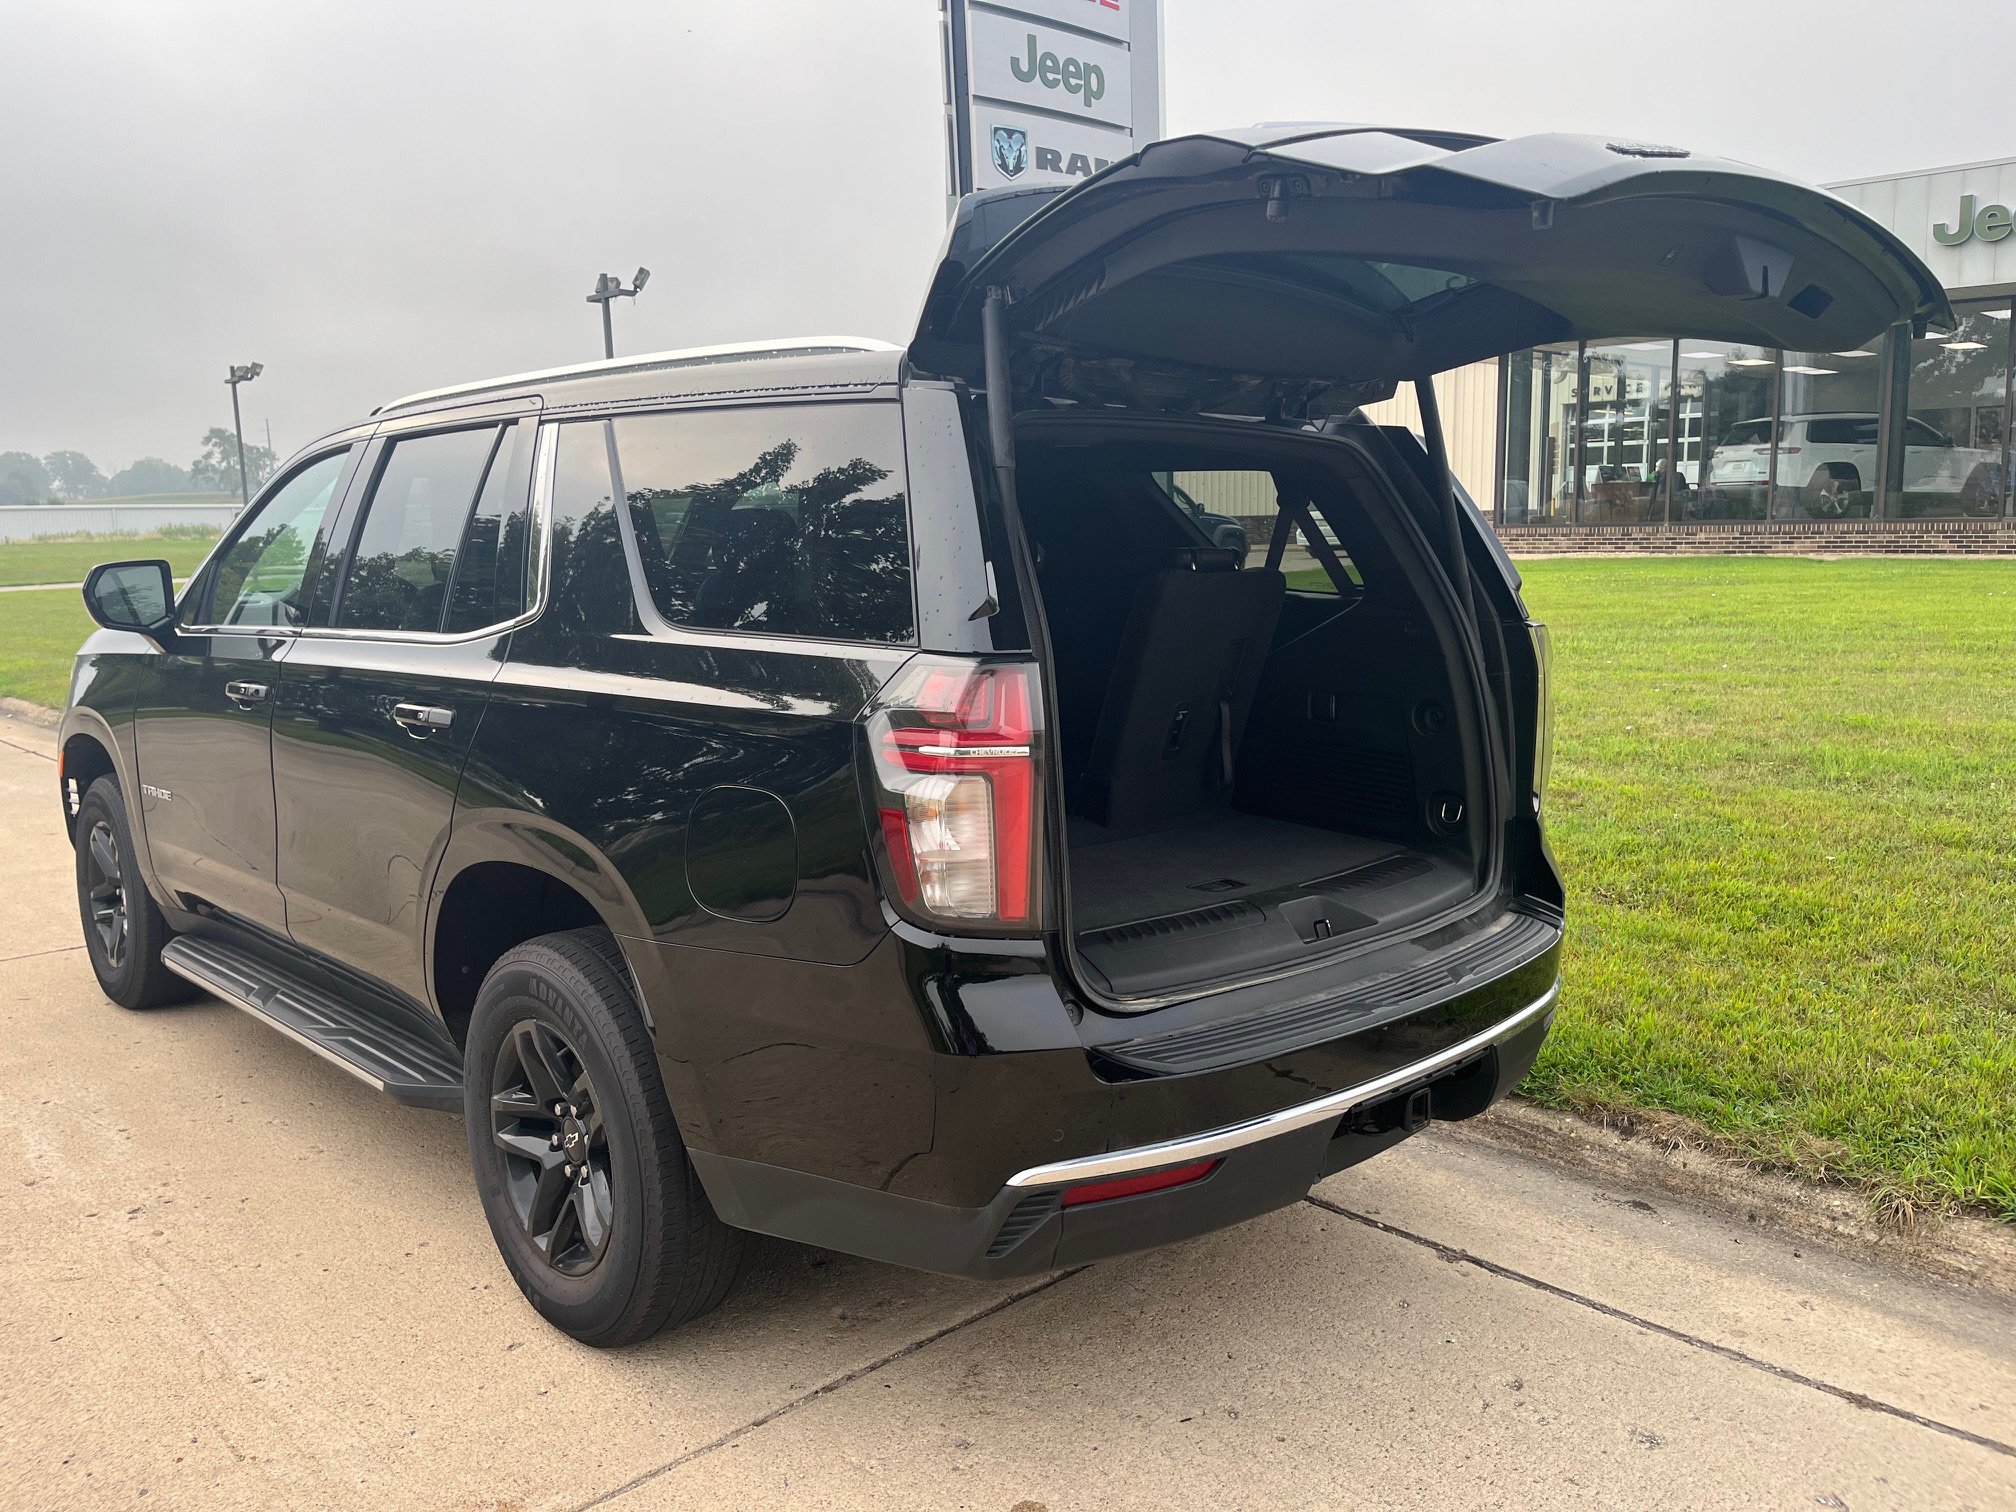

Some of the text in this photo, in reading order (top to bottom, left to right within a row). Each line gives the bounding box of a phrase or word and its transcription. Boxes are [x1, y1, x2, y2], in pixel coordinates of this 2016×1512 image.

[1010, 34, 1105, 107] Jeep
[1932, 194, 2016, 246] Je
[1571, 382, 1643, 398] SRVCE
[142, 784, 172, 802] TAHOE
